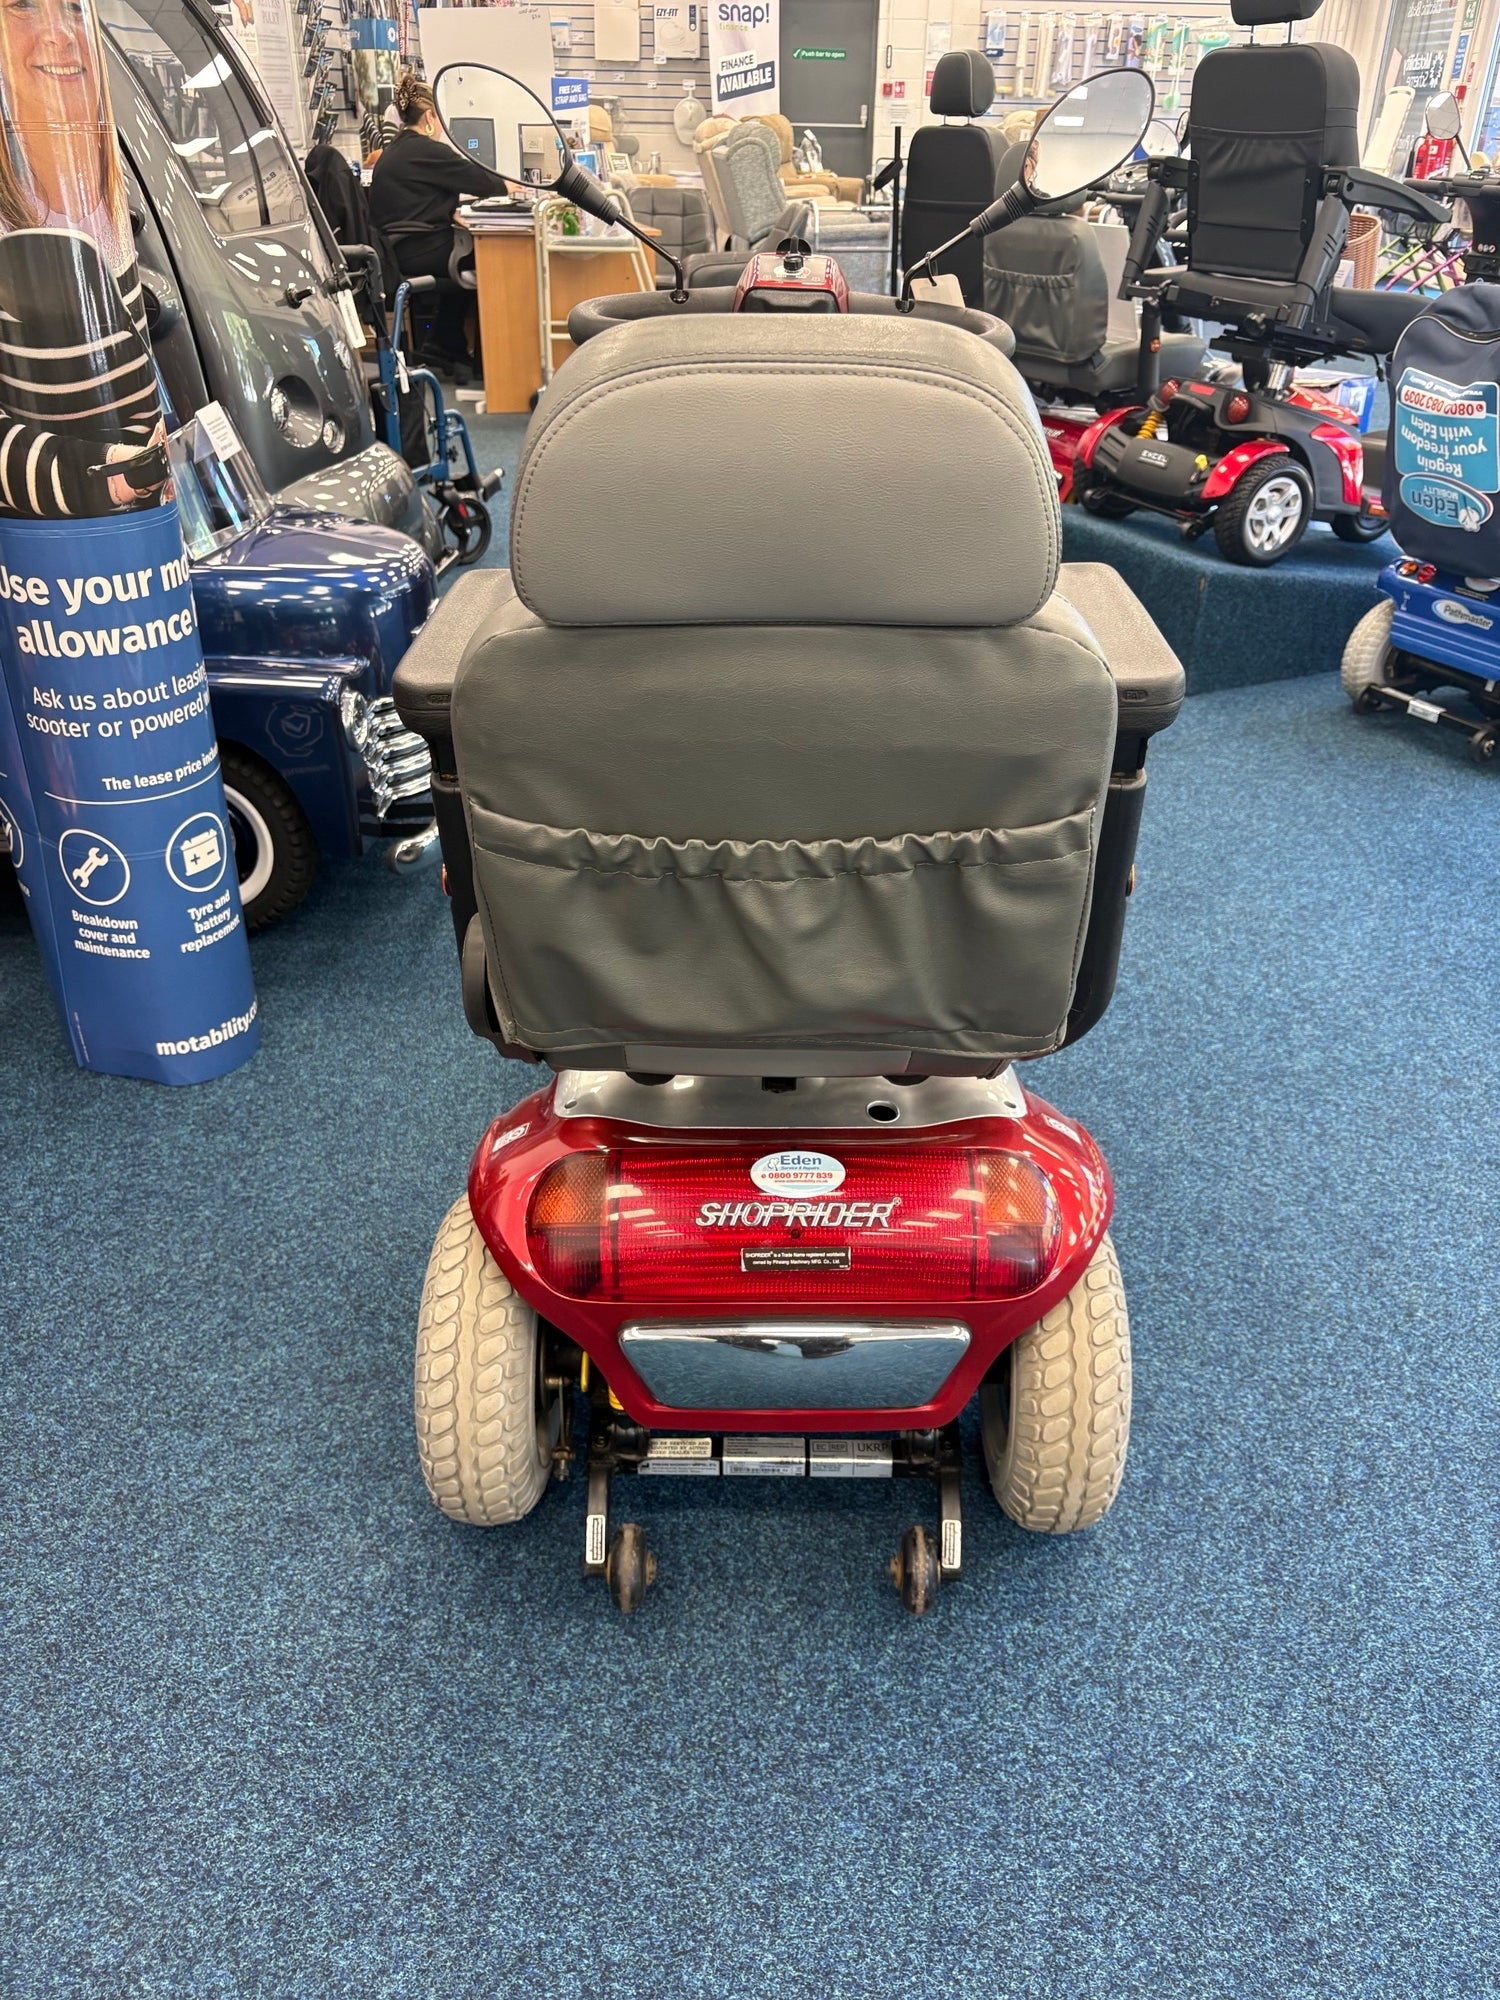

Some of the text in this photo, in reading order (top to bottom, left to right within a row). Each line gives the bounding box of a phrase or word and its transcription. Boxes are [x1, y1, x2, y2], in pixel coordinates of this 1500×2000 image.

[656, 8, 678, 17] EZY-FIT
[718, 3, 770, 28] snap!
[719, 23, 748, 31] finance
[720, 54, 754, 72] FINANCE
[558, 85, 570, 95] FREE
[719, 66, 773, 94] AVAILABLE
[1404, 389, 1426, 407] 2039
[1425, 396, 1444, 413] 083
[1411, 414, 1473, 442] with Eden
[1401, 424, 1488, 460] your freedom
[1140, 449, 1168, 463] EXCEL
[1417, 454, 1463, 478] Regain
[1423, 485, 1459, 500] MOBILITY
[1411, 491, 1459, 520] Eden
[56, 568, 152, 617] your
[1443, 604, 1491, 628] Pathmaster
[17, 608, 193, 658] allowance
[33, 686, 65, 710] Ask
[69, 693, 97, 711] us
[102, 681, 170, 710] about
[26, 712, 91, 738] scooter
[97, 720, 123, 738] or
[129, 692, 204, 739] powered
[102, 777, 132, 791] The
[135, 772, 173, 788] lease
[175, 761, 202, 782] price
[187, 889, 231, 921] Tyre and
[72, 909, 138, 930] Breakdown
[194, 907, 231, 934] battery
[79, 927, 137, 945] cover and
[180, 914, 241, 954] replacement
[74, 939, 151, 960] maintenance
[780, 1155, 822, 1165] Eden
[857, 1442, 889, 1452] UKRP
